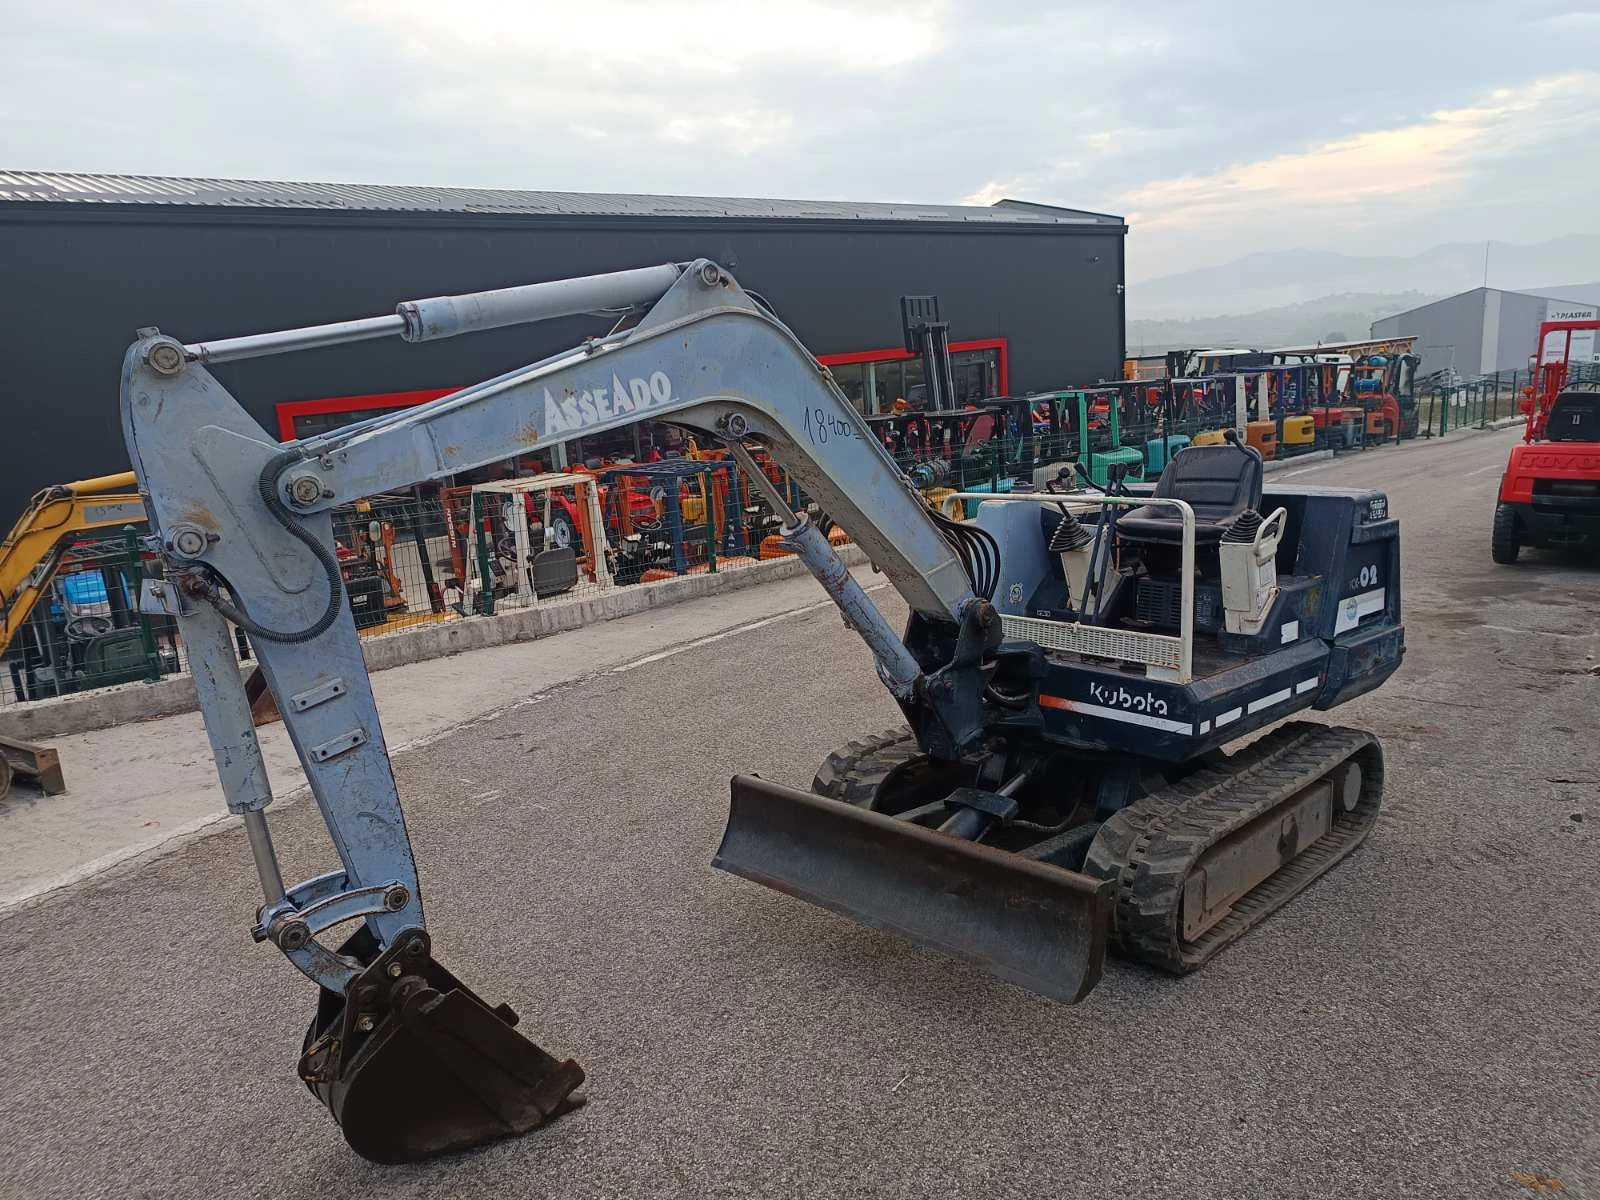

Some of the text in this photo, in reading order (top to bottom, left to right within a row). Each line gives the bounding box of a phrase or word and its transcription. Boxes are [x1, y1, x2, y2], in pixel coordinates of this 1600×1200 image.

[543, 371, 672, 436] ASSEADO
[446, 507, 457, 549] NISSAN
[1090, 682, 1168, 715] Kubota
